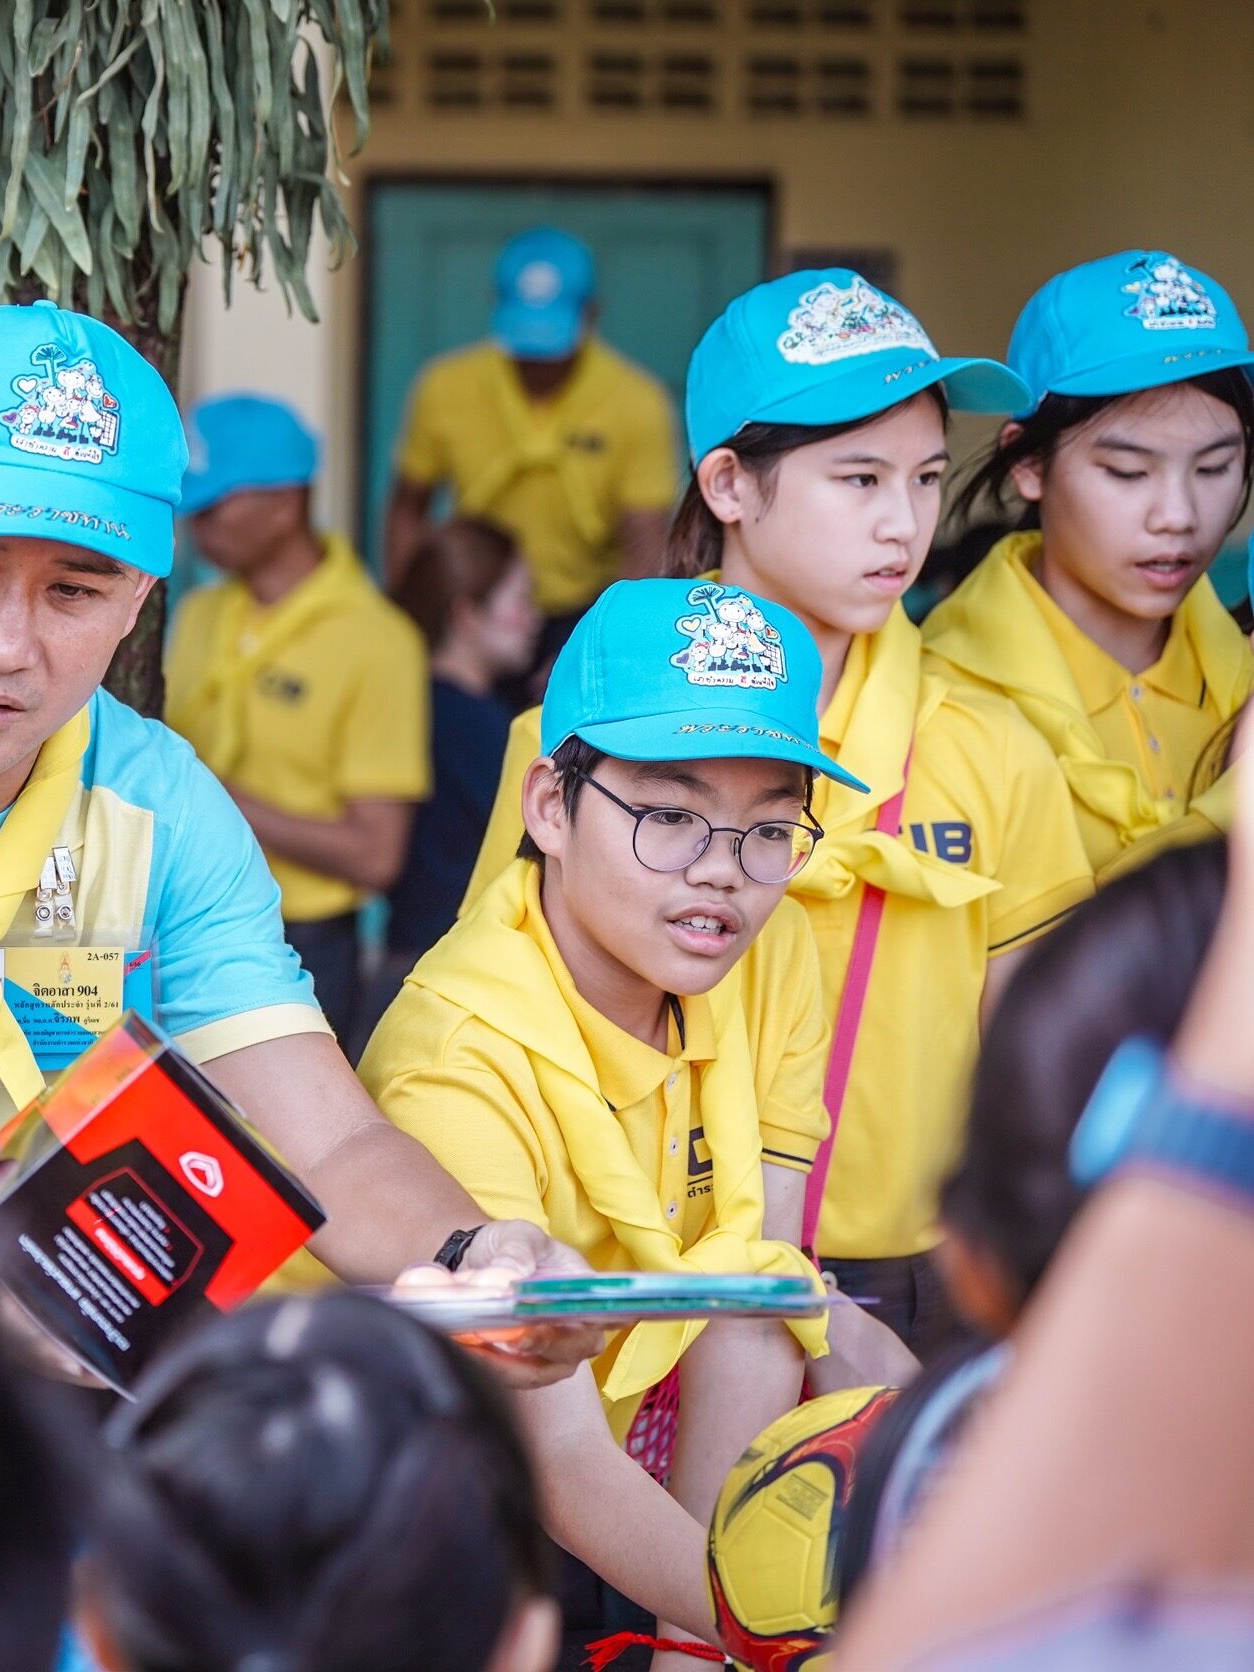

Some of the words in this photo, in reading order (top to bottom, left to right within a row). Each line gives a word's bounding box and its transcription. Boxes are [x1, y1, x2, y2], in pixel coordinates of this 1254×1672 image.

[897, 822, 972, 864] IB
[87, 952, 119, 961] 2A-057
[33, 982, 75, 997] จิตอาสา
[77, 985, 98, 997] 904
[86, 997, 102, 1011] รุ่นที่
[104, 1001, 119, 1009] 2/61
